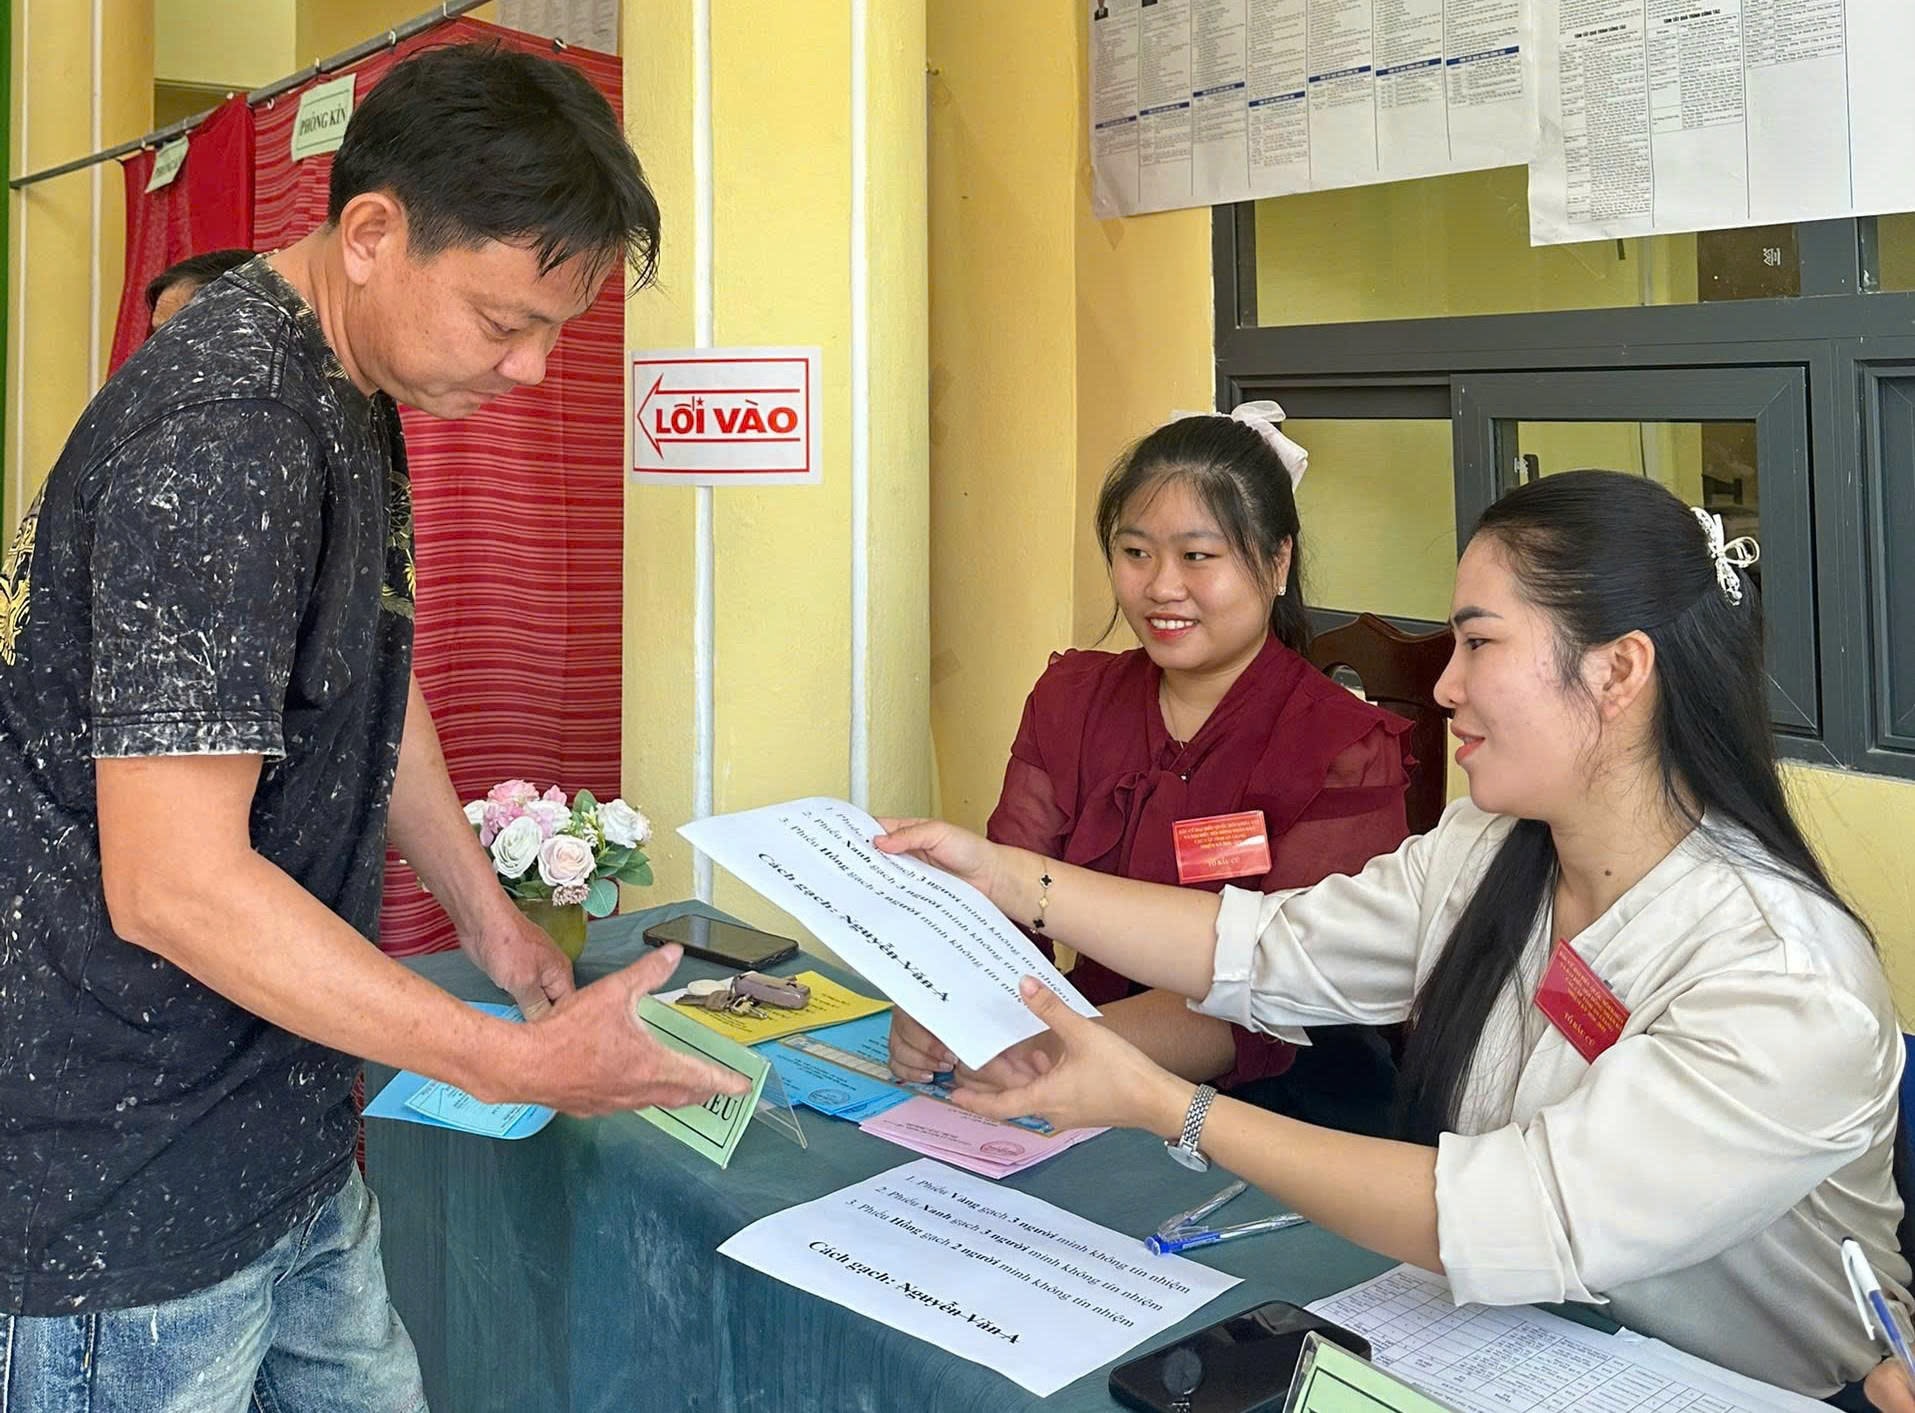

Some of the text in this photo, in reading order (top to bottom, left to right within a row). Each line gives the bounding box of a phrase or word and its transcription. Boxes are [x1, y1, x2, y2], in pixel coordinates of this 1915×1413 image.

[299, 103, 346, 136] PHÒNG KÍN
[713, 399, 798, 434] VÀO
[758, 853, 796, 882] Cách
[795, 883, 838, 913] gạch:
[838, 914, 899, 961] Nguyễn
[902, 960, 935, 989] Văn
[790, 825, 820, 848] Phiếu
[820, 847, 849, 872] Hồng
[884, 895, 921, 916] người
[920, 916, 948, 939] mình
[949, 939, 983, 968] không
[984, 968, 1000, 981] tín
[814, 818, 842, 840] Phiếu
[842, 839, 871, 863] Xanh
[941, 909, 969, 932] mình
[970, 932, 1003, 960] không
[1003, 961, 1019, 975] tín
[962, 903, 988, 926] mình
[989, 926, 1020, 956] không
[808, 1240, 1020, 1345] Cách gạch: Nguyễn Văn A
[858, 1203, 890, 1221] Phiếu
[889, 1216, 923, 1236] Hồng
[920, 1232, 951, 1247] gạch
[950, 1242, 963, 1250] 2
[960, 1247, 1001, 1267] người
[998, 1263, 1032, 1282] mình
[1031, 1278, 1072, 1301] không
[1072, 1297, 1092, 1309] tín
[1092, 1306, 1135, 1328] nhiệm
[888, 1190, 920, 1207] Phiếu
[919, 1203, 952, 1220] Xanh
[949, 1218, 980, 1232] gạch
[990, 1233, 1031, 1252] người
[1028, 1249, 1061, 1267] mình
[1060, 1263, 1101, 1285] không
[1101, 1281, 1121, 1294] tín
[1121, 1290, 1164, 1312] nhiệm
[917, 1180, 949, 1196] Phiếu
[951, 1192, 981, 1210] Vàng
[979, 1206, 1008, 1221] gạch
[1019, 1221, 1059, 1240] người
[1056, 1237, 1088, 1253] mình
[1089, 1249, 1128, 1270] không
[1129, 1265, 1148, 1278] tín
[1149, 1274, 1191, 1295] nhiệm
